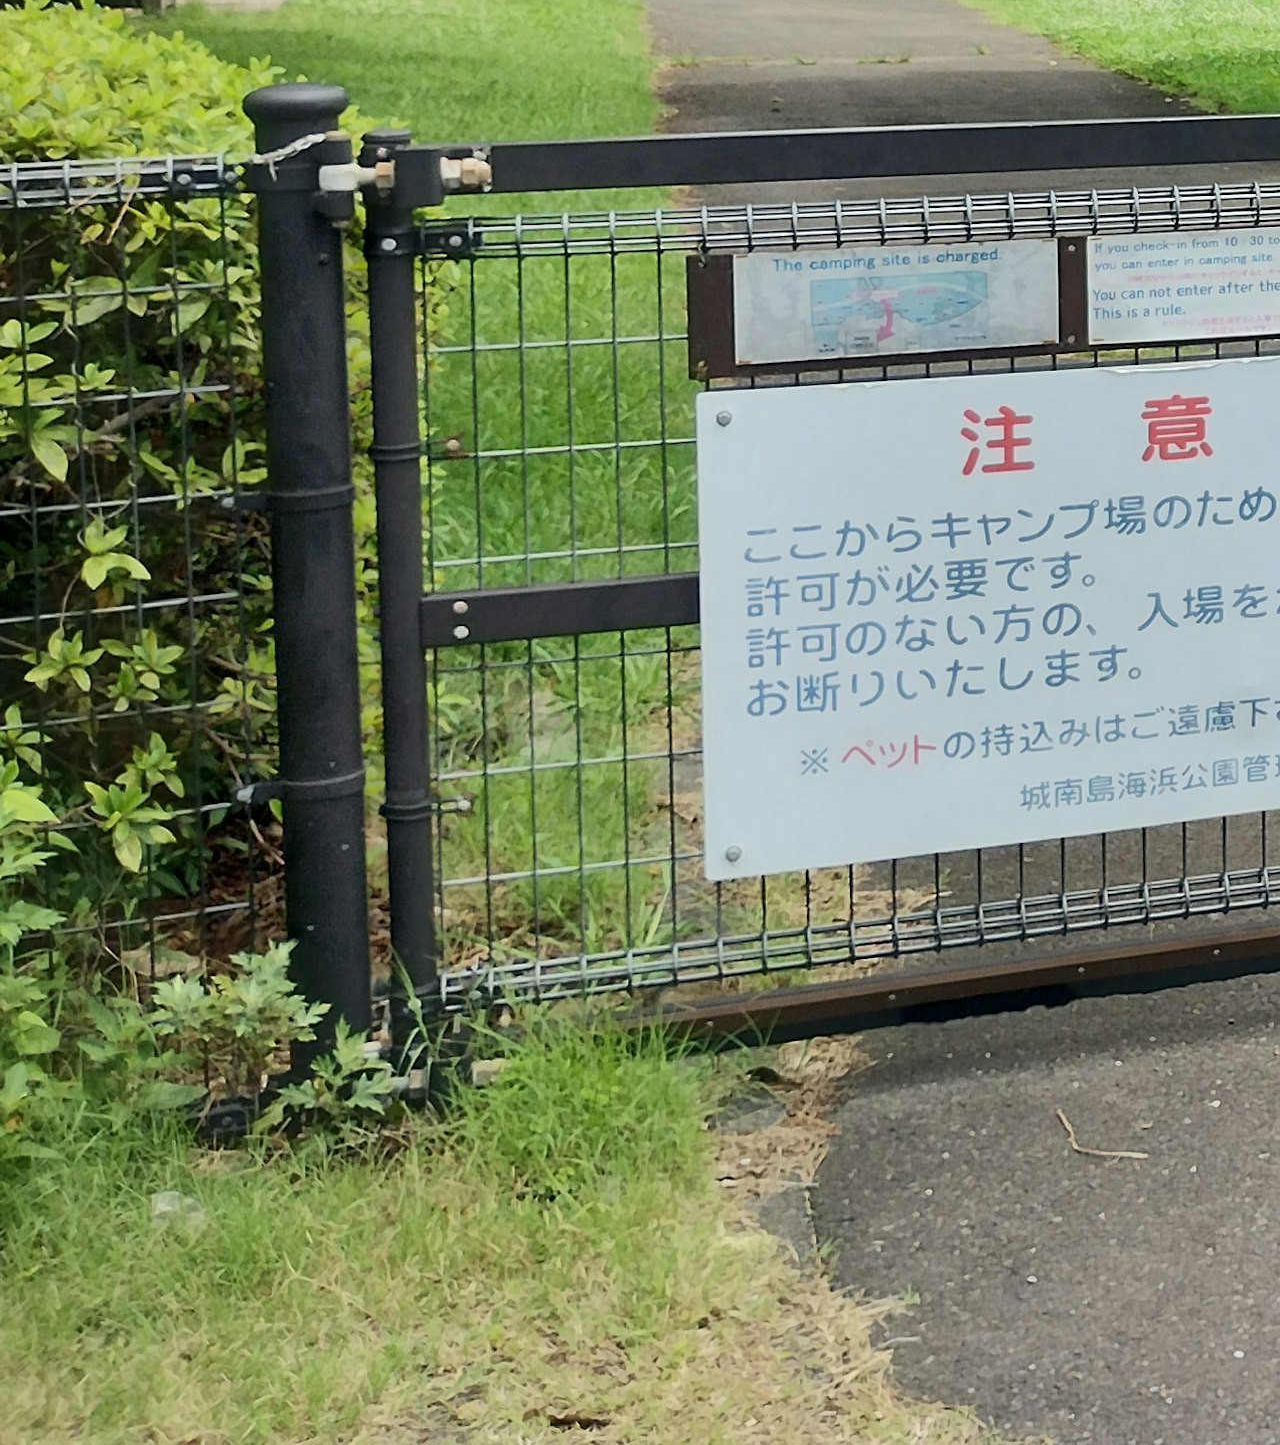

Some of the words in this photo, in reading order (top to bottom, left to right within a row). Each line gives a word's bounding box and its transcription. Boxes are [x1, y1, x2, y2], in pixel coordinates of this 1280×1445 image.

[1107, 244, 1129, 254] you
[1192, 239, 1219, 249] from
[1268, 236, 1280, 245] to
[773, 257, 803, 272] The
[809, 252, 875, 270] camping
[882, 251, 911, 267] site
[917, 253, 930, 265] is
[1095, 261, 1117, 272] you
[1121, 260, 1143, 270] can
[1147, 258, 1179, 268] enter
[1184, 257, 1195, 266] in
[1199, 254, 1247, 265] camping
[1093, 289, 1117, 302] You
[1121, 289, 1144, 300] can
[1149, 286, 1171, 298] not
[1176, 285, 1214, 297] enter
[1218, 282, 1253, 294] after
[1093, 306, 1122, 320] This
[1127, 307, 1138, 318] is
[1143, 307, 1150, 317] a
[1155, 304, 1187, 317] rule.
[746, 551, 1098, 618] 許可が必要です。
[746, 644, 1143, 716] お断りいたします。
